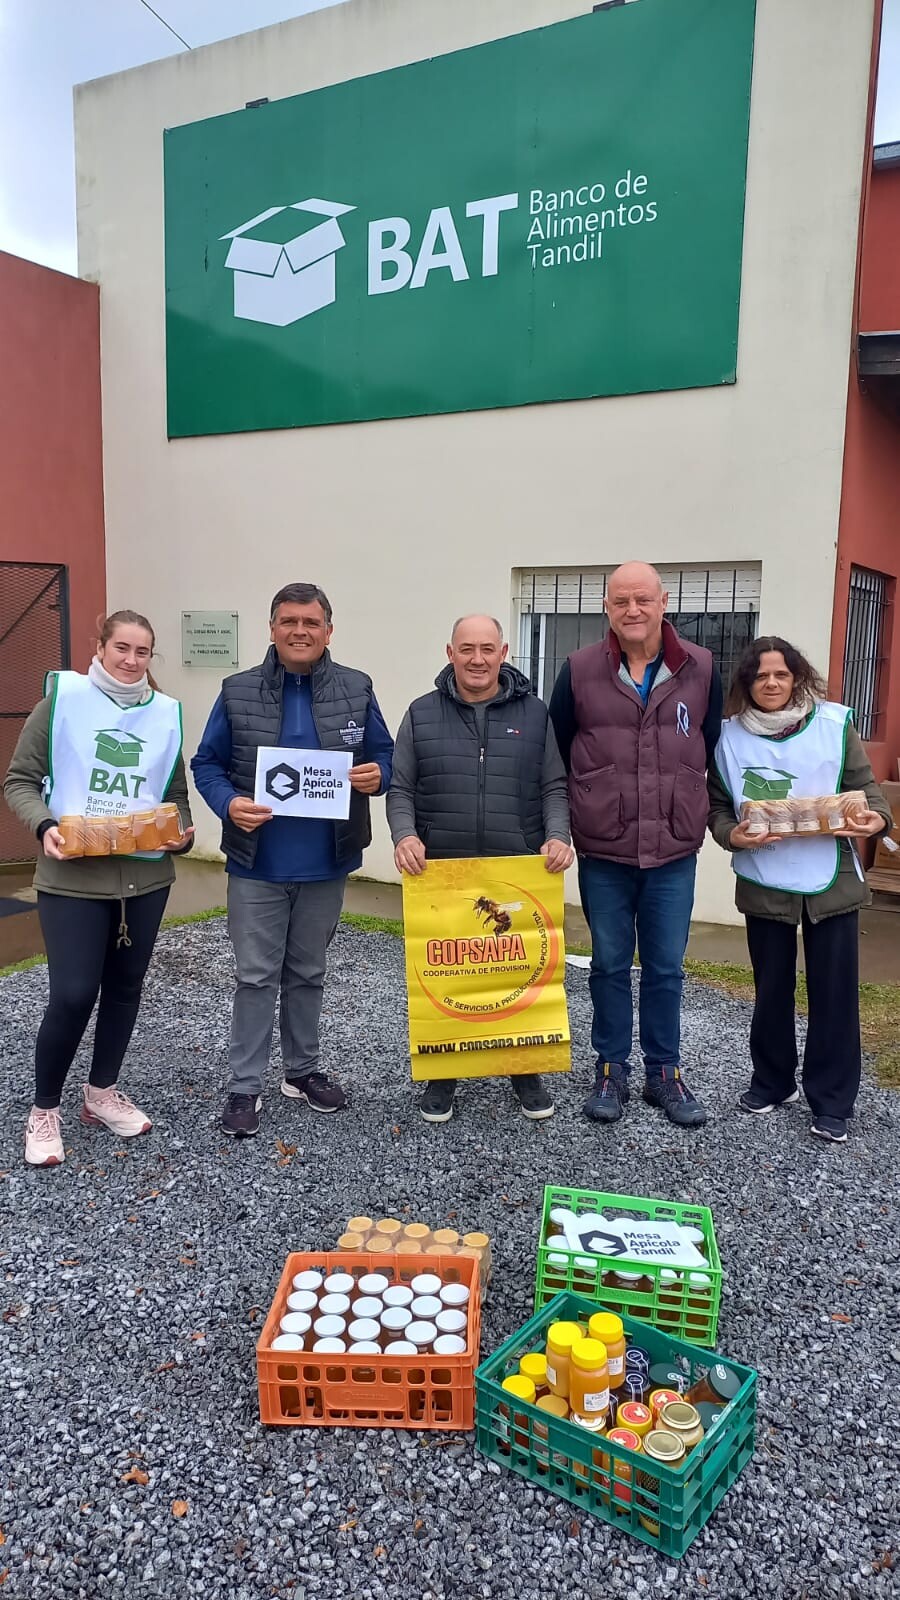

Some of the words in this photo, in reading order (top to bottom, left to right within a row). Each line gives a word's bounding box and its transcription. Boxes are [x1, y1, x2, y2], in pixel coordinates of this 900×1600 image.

[529, 183, 606, 215] Banco
[614, 169, 649, 198] de
[527, 200, 659, 243] Alimentos
[368, 192, 519, 296] BAT
[527, 231, 603, 269] Tandil
[88, 767, 147, 799] BAT
[303, 766, 332, 777] Mesa
[302, 789, 335, 799] Tandil
[303, 777, 343, 790] Apícola
[87, 796, 114, 807] Banco
[115, 801, 127, 810] de
[427, 934, 527, 967] COPSAPA
[423, 968, 477, 977] COOPERATIVA
[478, 967, 489, 975] DE
[490, 964, 530, 973] PROVISION
[443, 996, 454, 1007] DE
[454, 1001, 494, 1012] SERVICIOS
[501, 967, 543, 1006] PRODUCTORES
[623, 1232, 662, 1240] Mesa
[630, 1247, 677, 1256] Tandil
